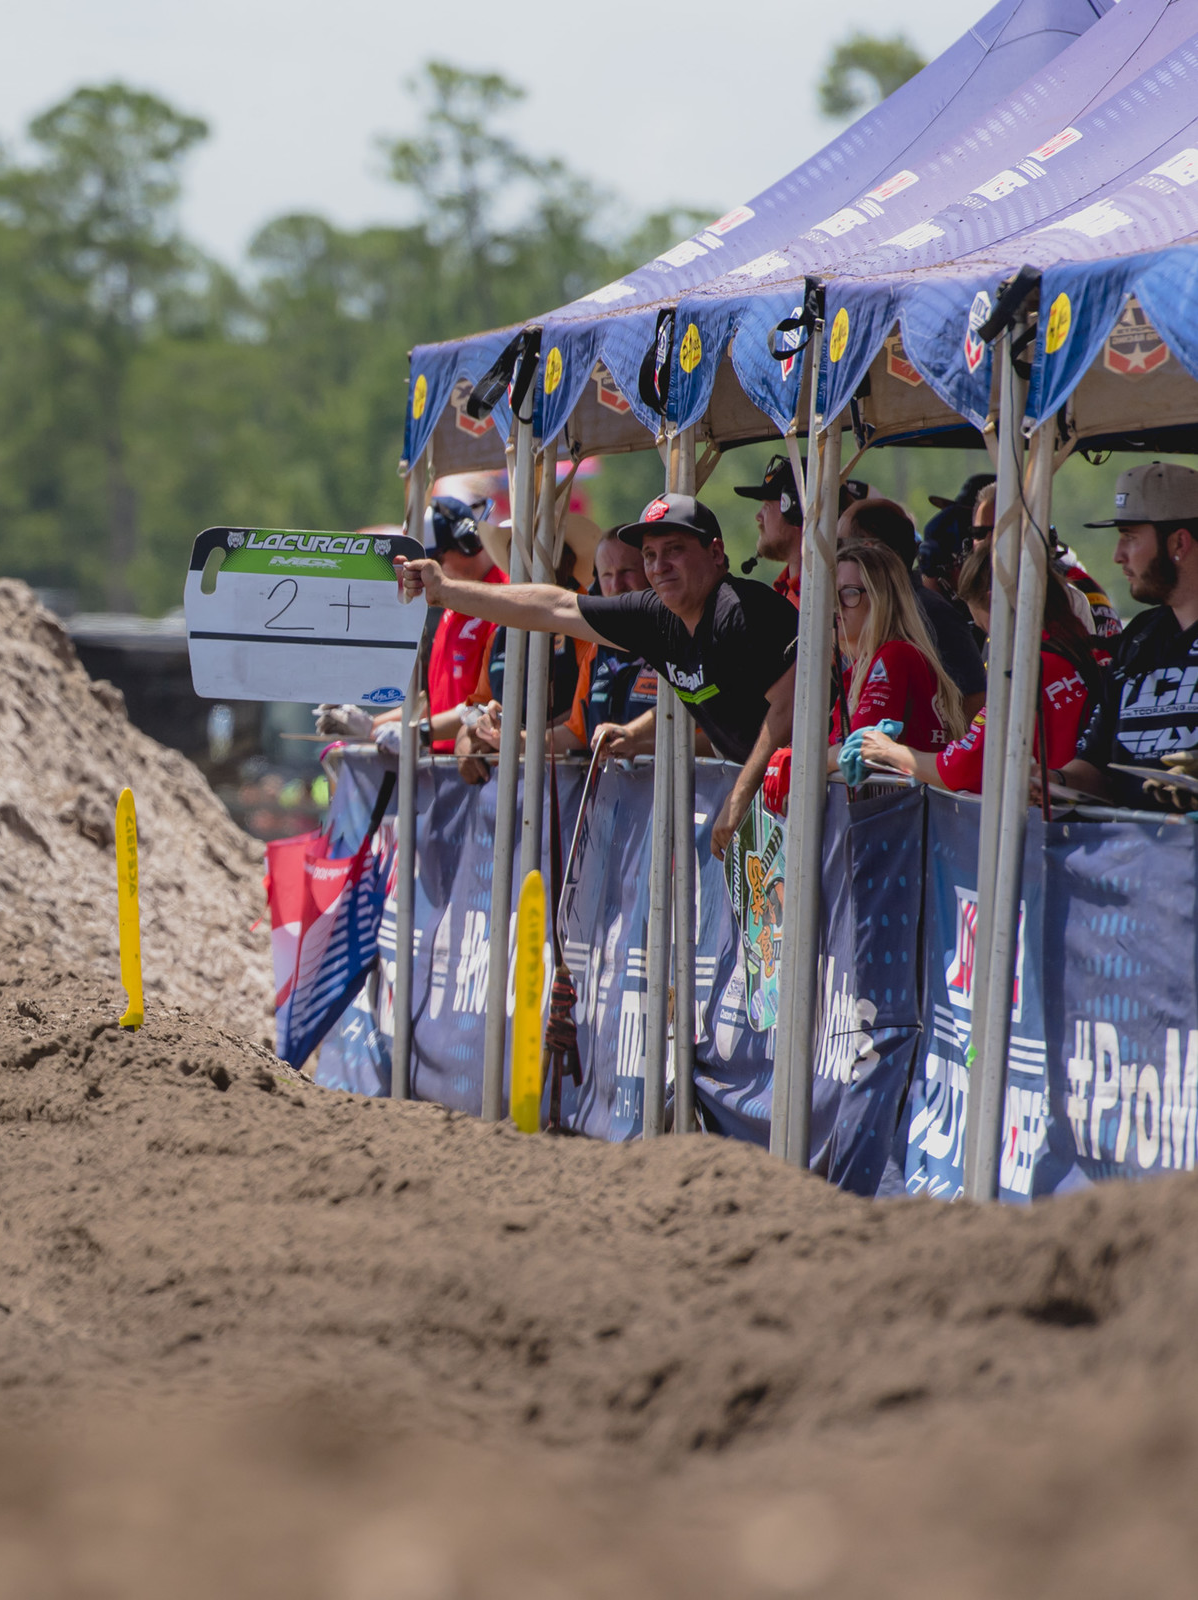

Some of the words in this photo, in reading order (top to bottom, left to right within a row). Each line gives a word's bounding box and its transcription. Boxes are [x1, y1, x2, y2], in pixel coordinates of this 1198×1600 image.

[245, 532, 372, 556] LOCURCIO
[264, 578, 315, 630] 2
[329, 584, 371, 632] +
